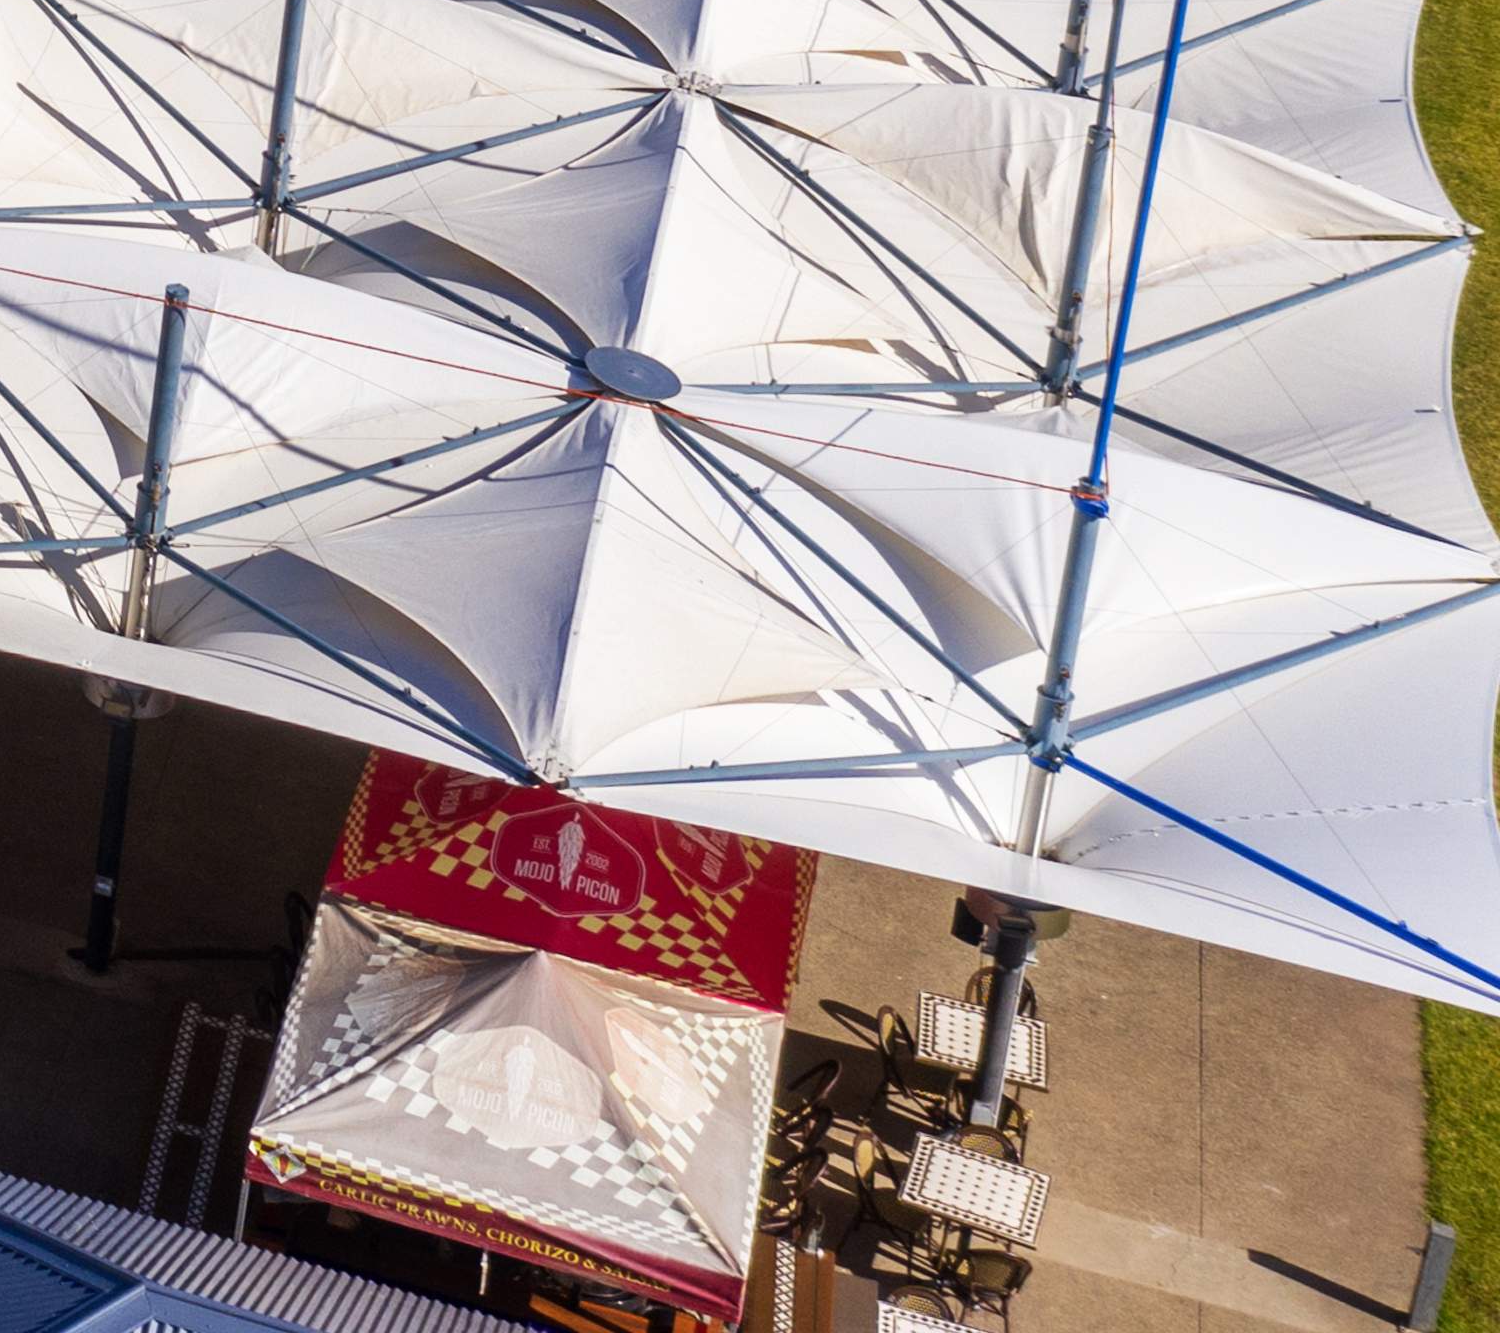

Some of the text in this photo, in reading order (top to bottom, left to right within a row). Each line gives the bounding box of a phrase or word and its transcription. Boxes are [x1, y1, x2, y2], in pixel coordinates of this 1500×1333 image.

[533, 837, 551, 851] EST.
[514, 858, 621, 906] MOJO PICÓN
[457, 1085, 502, 1115] MOJO
[395, 1200, 482, 1238] PRAWNS,
[486, 1227, 579, 1265] CHORIZO
[583, 1258, 597, 1270] &
